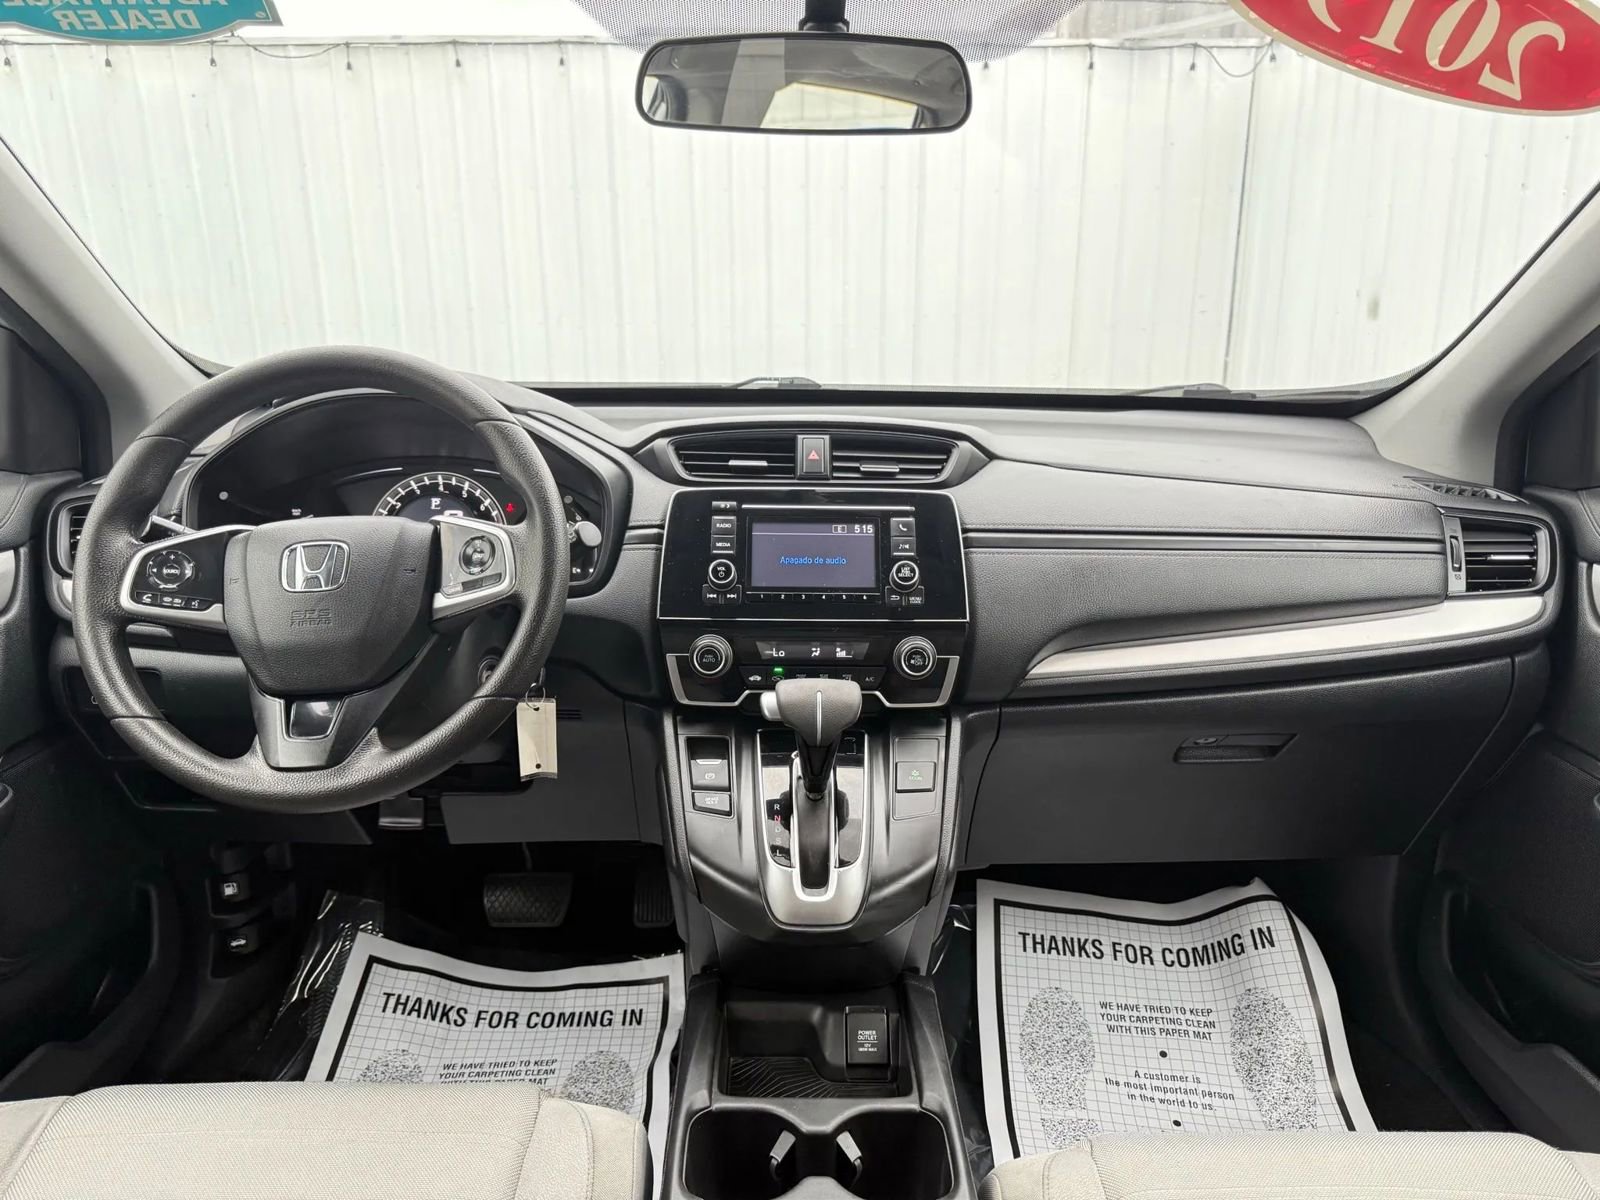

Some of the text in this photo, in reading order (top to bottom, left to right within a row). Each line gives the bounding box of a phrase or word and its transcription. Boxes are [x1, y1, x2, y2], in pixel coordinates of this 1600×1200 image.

[780, 556, 846, 566] Apagado de audio
[774, 814, 781, 822] N
[1018, 925, 1276, 968] THANKS FOR COMING IN
[382, 992, 643, 1029] THANKS FOR COMING IN
[1099, 1001, 1213, 1017] WE HAVE TRIED TO KEEP
[1100, 1012, 1216, 1029] YOUR CARPETING CLEAN
[1106, 1024, 1213, 1041] WITH THIS PAPER MAT
[443, 1063, 458, 1071] WE
[460, 1062, 485, 1070] HAVE
[487, 1060, 516, 1069] TRIED
[533, 1058, 558, 1067] KEEP
[439, 1068, 556, 1080] YOUR CARPETING CLEAN
[1134, 1069, 1201, 1084] A customer is
[1104, 1077, 1235, 1101] the most important person
[1127, 1091, 1217, 1111] in the world to us.
